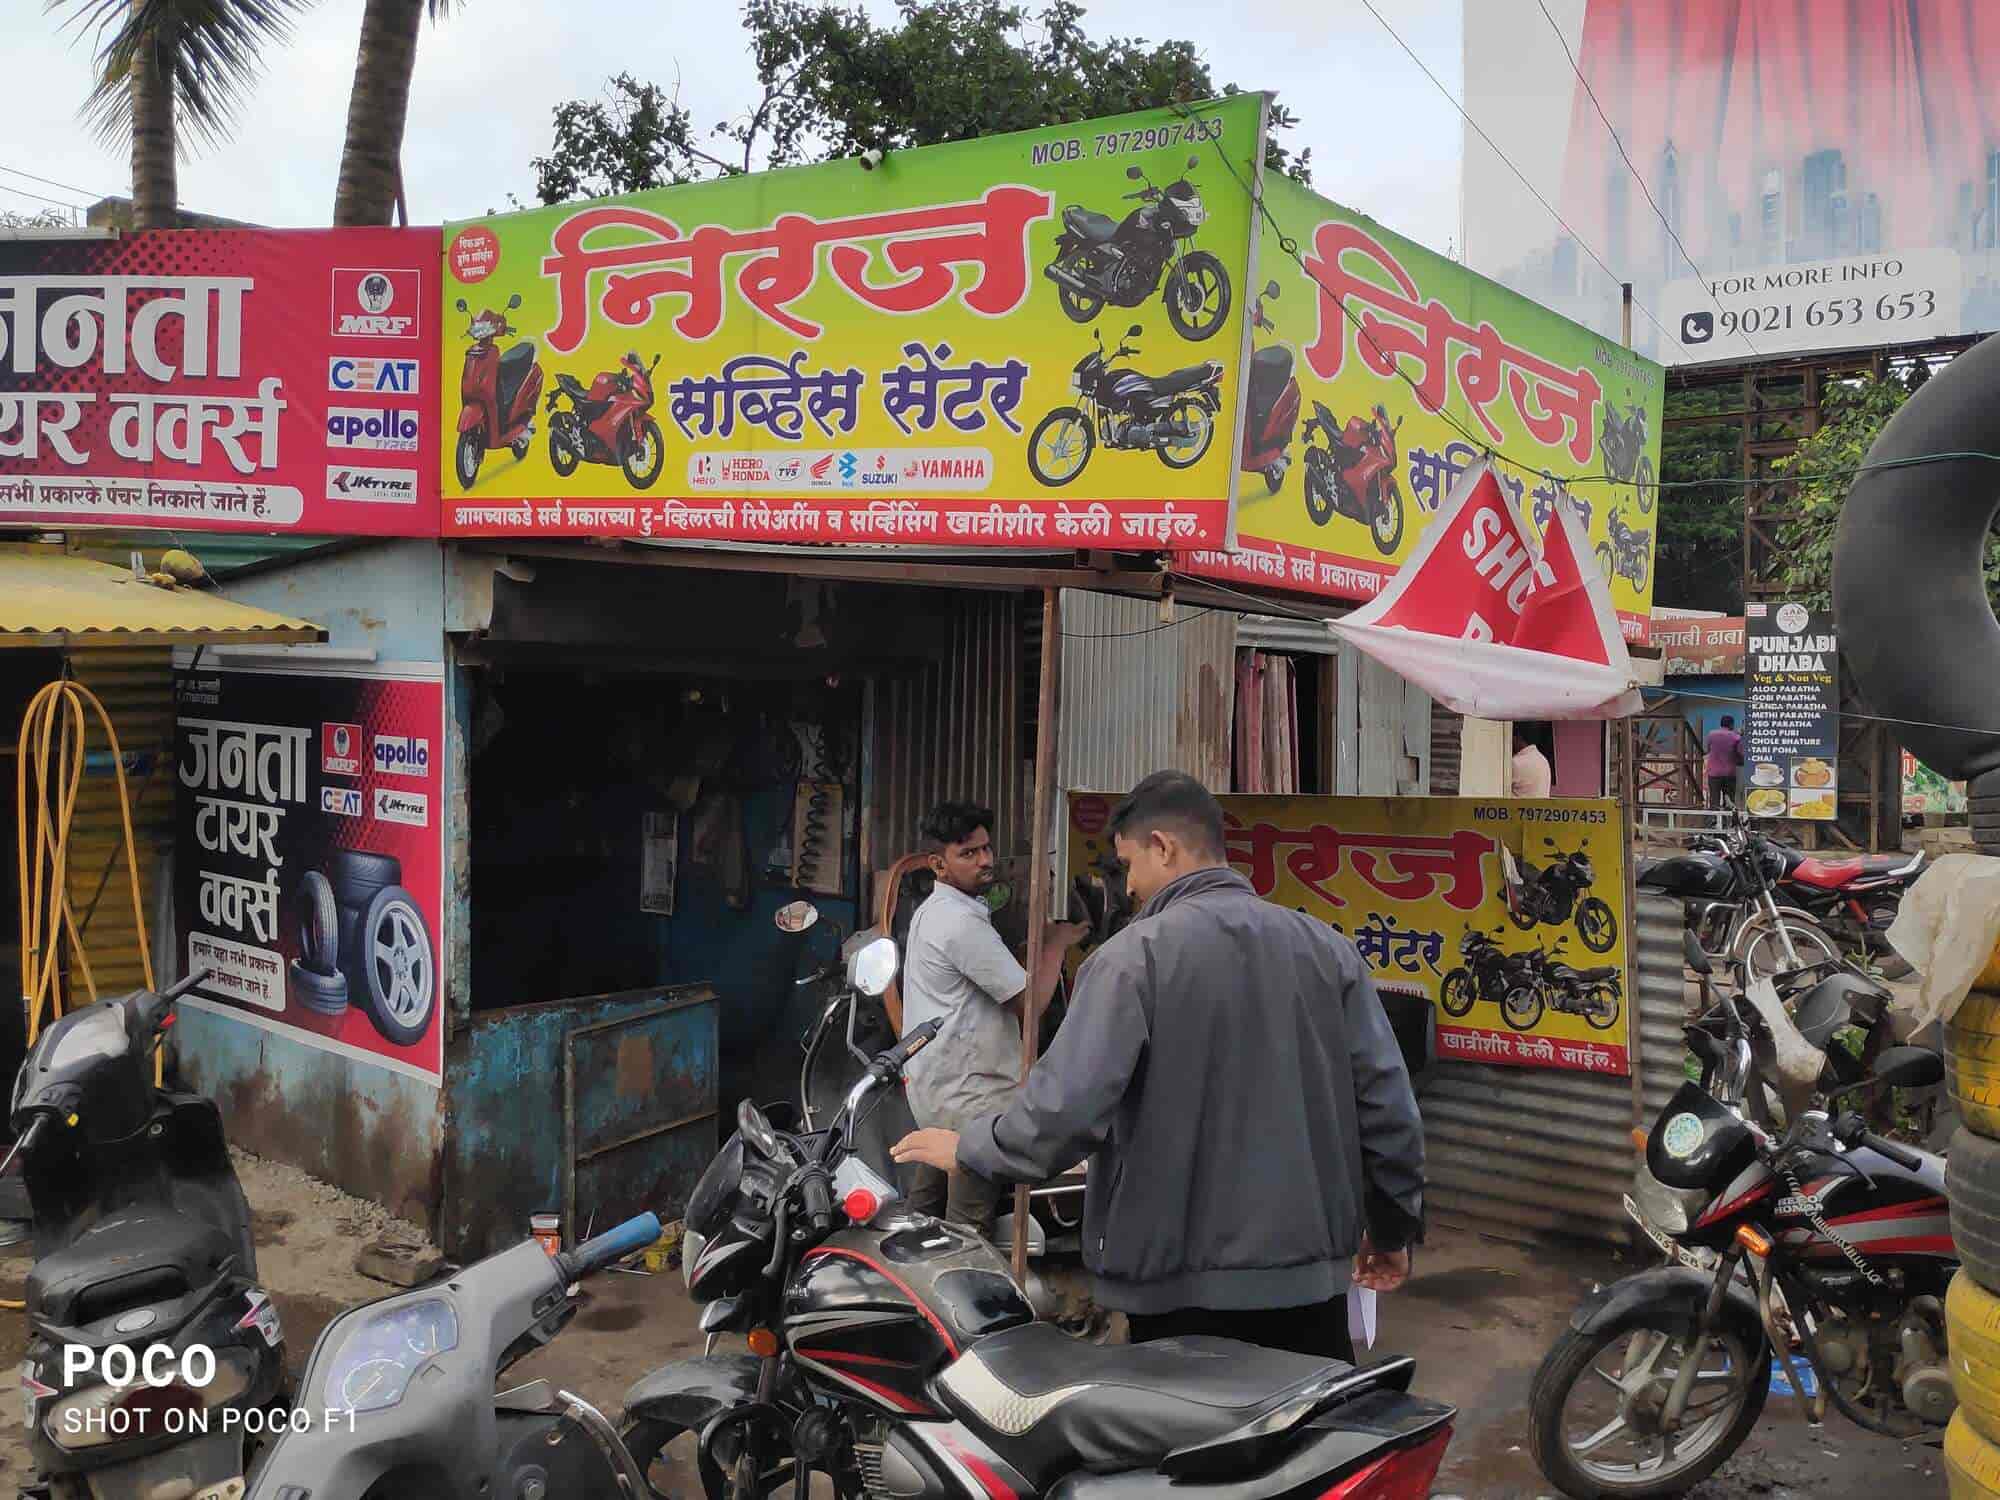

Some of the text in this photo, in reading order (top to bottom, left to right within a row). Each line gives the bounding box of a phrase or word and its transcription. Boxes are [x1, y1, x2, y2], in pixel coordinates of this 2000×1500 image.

[1032, 118, 1223, 165] MOB. 7972907453
[541, 184, 1056, 354] निरज
[1710, 260, 1903, 297] FOR MORE INFO
[338, 314, 412, 335] MRF
[1720, 289, 1936, 337] 9021 653 653
[1304, 220, 1601, 465] निरज
[331, 360, 417, 391] CEAT
[883, 344, 1031, 435] सेंटर
[328, 408, 418, 445] apollo
[375, 439, 417, 450] TYRES
[732, 458, 763, 469] HERO
[732, 471, 771, 482] HONDA
[778, 468, 798, 477] TVS
[921, 459, 985, 479] YAMAHA
[862, 473, 898, 485] SUZUKI
[148, 482, 206, 510] निकाले
[210, 486, 249, 512] जाते
[538, 499, 561, 525] सर्व
[826, 509, 842, 529] व
[945, 503, 1046, 537] खात्रीशीर
[1054, 502, 1112, 537] केली
[1120, 502, 1207, 543] जाईल.
[1748, 634, 1836, 653] PUNJABI
[1753, 673, 1832, 684] Veg & Non Veg
[1758, 655, 1826, 672] DHABA
[1752, 685, 1777, 693] ALOO
[1752, 729, 1777, 737] ALOO
[176, 717, 312, 804] जनता
[375, 736, 427, 770] apollo
[323, 790, 361, 815] CEAT
[1517, 807, 1608, 824] 7972907453
[195, 796, 287, 868] टायर
[1354, 911, 1445, 977] सेंटर
[1441, 1030, 1618, 1072] खात्रीशीर केली जाईल.
